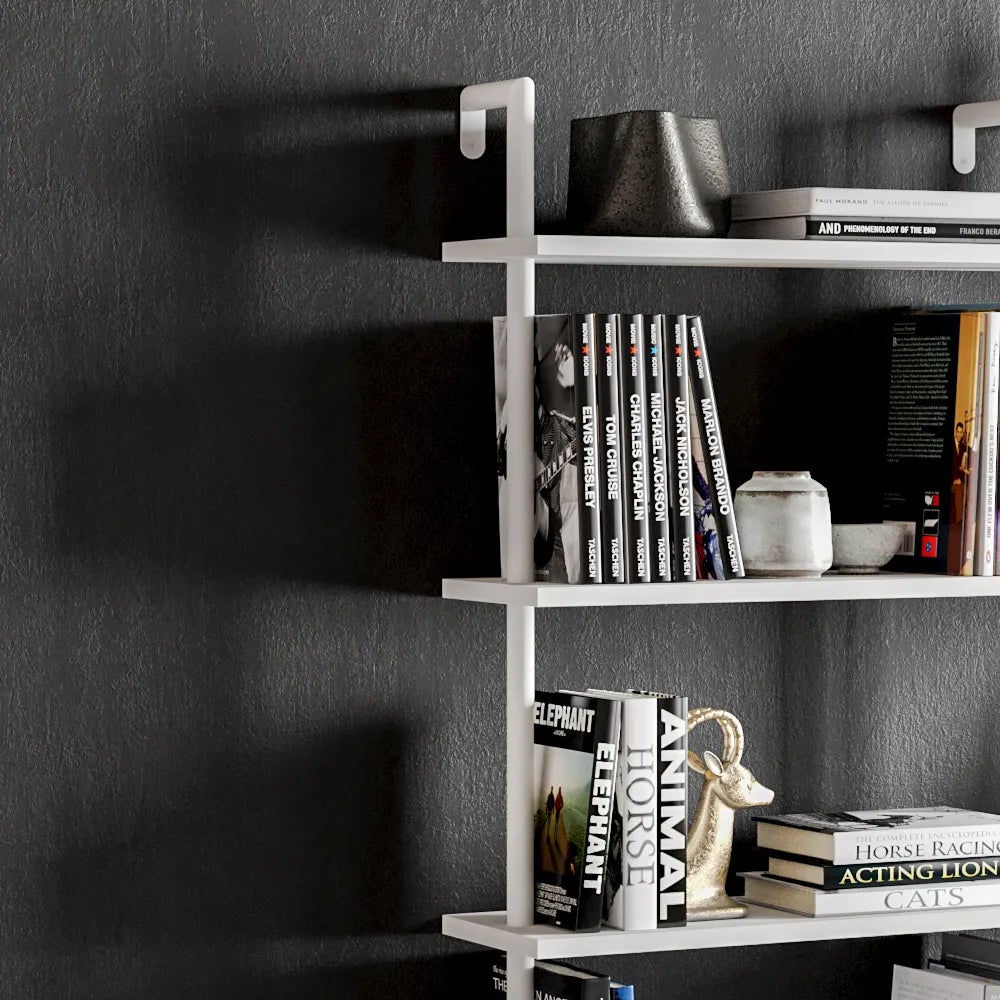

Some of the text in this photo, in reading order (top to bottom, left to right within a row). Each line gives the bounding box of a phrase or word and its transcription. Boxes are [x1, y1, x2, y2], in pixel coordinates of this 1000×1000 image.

[819, 222, 937, 235] AND PHENOMENOLOGY OF THE END
[959, 227, 984, 236] FRANCO
[582, 406, 596, 509] ELVIS PRESLEY
[605, 414, 619, 500] TOM CRUISE
[629, 394, 645, 521] CHARLES CHAPLIN
[650, 392, 666, 522] MICHAEL JACKSON
[675, 397, 690, 517] JACK NICHOLSON
[700, 399, 730, 515] MARLON BRANDO
[588, 538, 597, 578] TASCHEN
[611, 537, 620, 578] TASCHEN
[636, 537, 646, 577] TASCHEN
[657, 537, 667, 577] TASCHEN
[682, 536, 691, 576] TASCHEN
[726, 534, 739, 573] TASCHEN
[534, 702, 595, 733] ELEPHANT
[583, 742, 615, 895] ELEPHANT
[626, 744, 656, 886] HORSE
[660, 708, 687, 921] ANIMAL
[855, 843, 926, 860] HORSE
[839, 863, 934, 885] ACTING
[884, 887, 964, 909] CATS
[493, 977, 507, 993] THE
